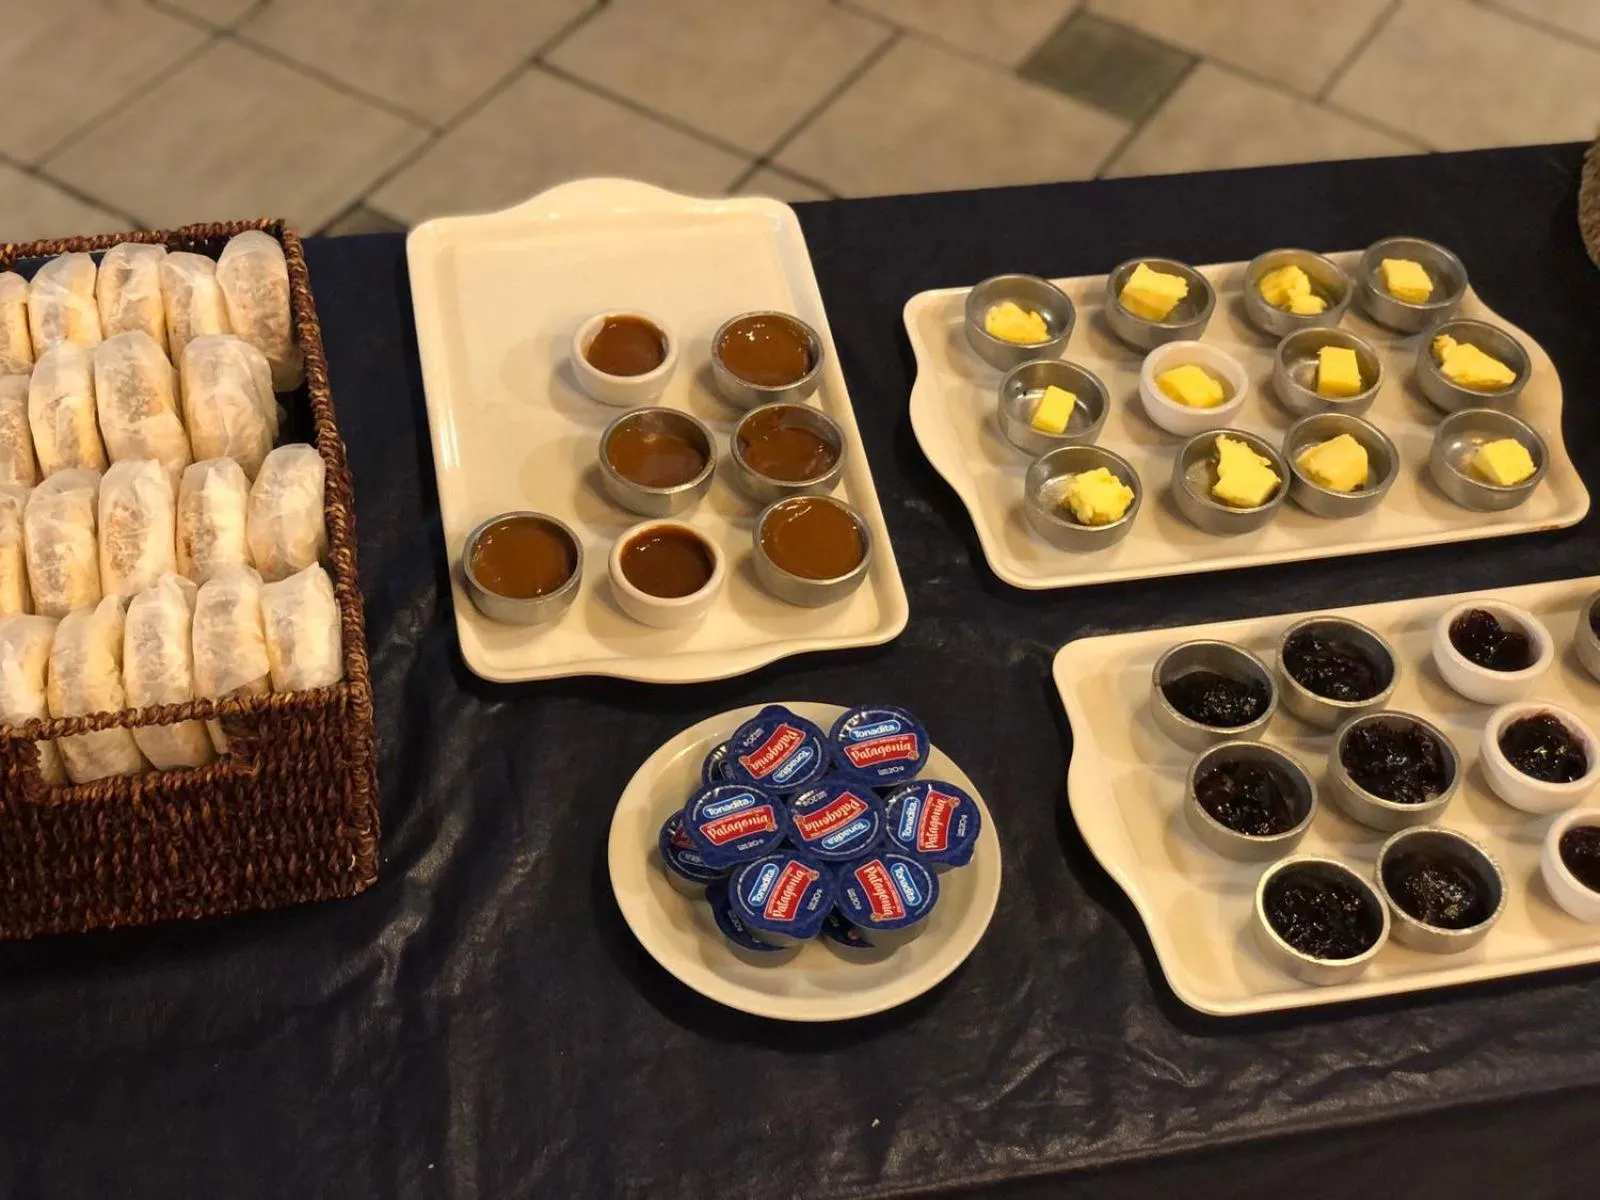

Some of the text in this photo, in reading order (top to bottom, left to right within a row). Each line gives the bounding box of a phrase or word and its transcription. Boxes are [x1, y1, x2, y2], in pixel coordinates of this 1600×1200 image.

[852, 724, 896, 738] Tonadita
[750, 729, 799, 770] Patagonia
[851, 741, 912, 761] Patagonia
[707, 799, 749, 816] Tonadita
[804, 799, 861, 832] Patagonia
[925, 798, 948, 849] Patagonia
[707, 814, 769, 839] Patagonia
[751, 869, 775, 902] Tonadita
[772, 870, 806, 917] Patagonia
[863, 866, 893, 915] Patagonia
